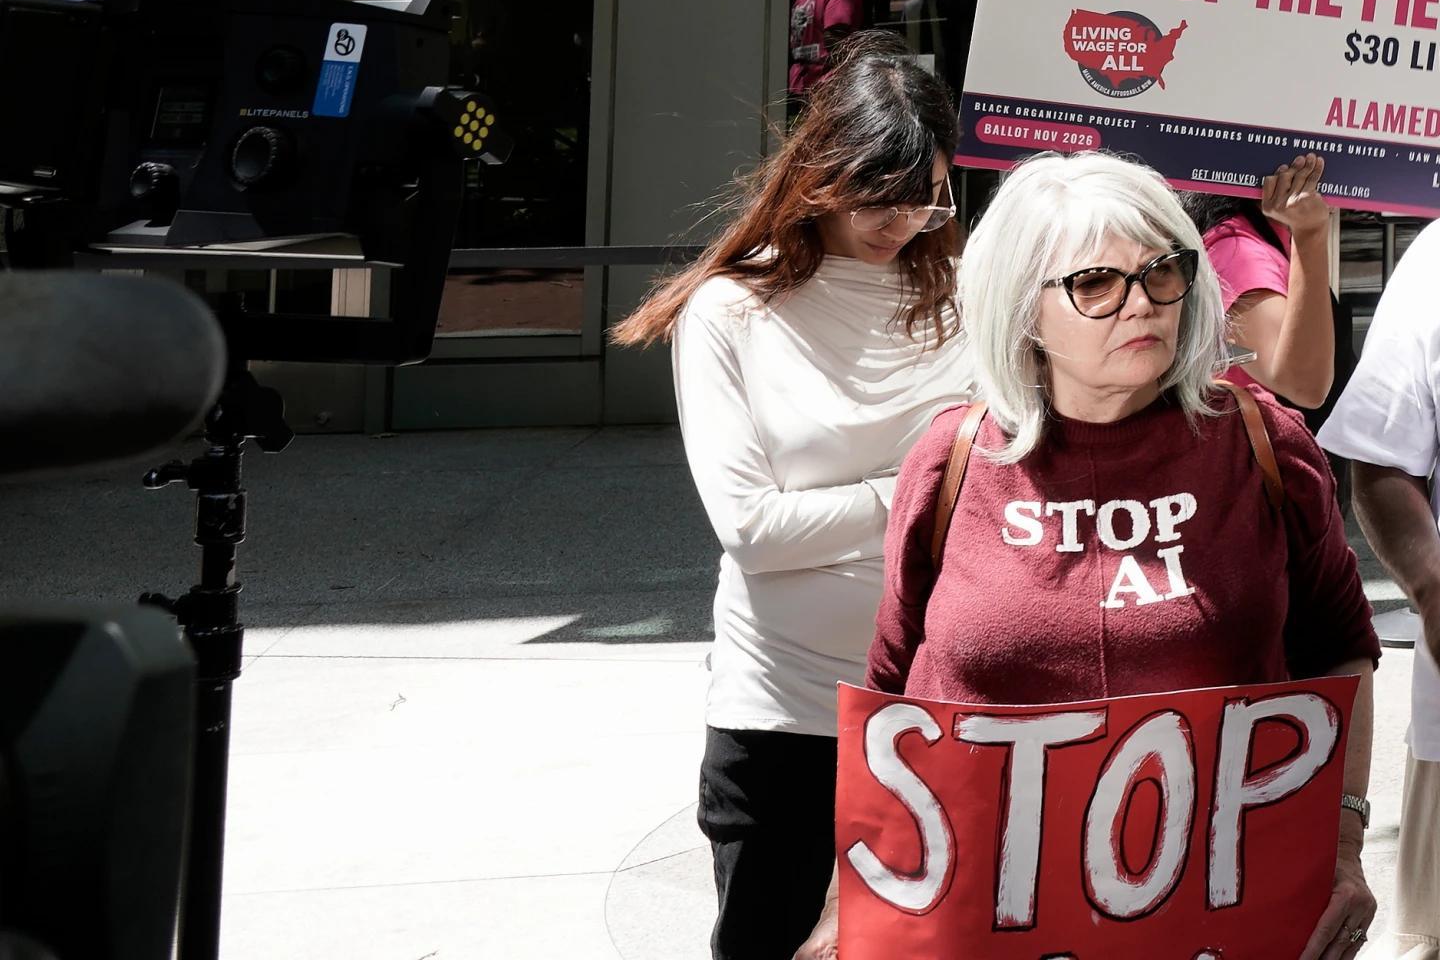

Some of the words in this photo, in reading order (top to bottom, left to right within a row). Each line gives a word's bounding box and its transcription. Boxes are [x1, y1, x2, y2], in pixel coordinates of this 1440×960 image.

[1071, 26, 1131, 41] LIVING
[1073, 41, 1114, 52] WAGE
[1118, 42, 1147, 53] FOR
[1344, 30, 1400, 66] $30
[1101, 54, 1144, 71] ALL
[1090, 78, 1110, 95] AMERICA
[246, 107, 309, 119] LITEPANELS
[974, 102, 1010, 115] BLACK
[1015, 106, 1083, 123] ORGANIZING
[1088, 115, 1137, 128] PROJECT
[1159, 123, 1243, 142] TRABAJADORES
[1247, 133, 1288, 147] UNIDOS
[1293, 139, 1343, 153] WORKERS
[1348, 144, 1386, 158] UNITED
[1408, 151, 1430, 164] UAW
[984, 123, 1030, 139] BALLOT
[1034, 129, 1058, 142] NOV
[1062, 133, 1093, 146] 2026
[1191, 168, 1208, 180] GET
[1316, 182, 1370, 198] FORALL.ORG
[1001, 492, 1198, 552] STOP
[1099, 544, 1196, 609] AI
[845, 692, 1342, 932] STOP
